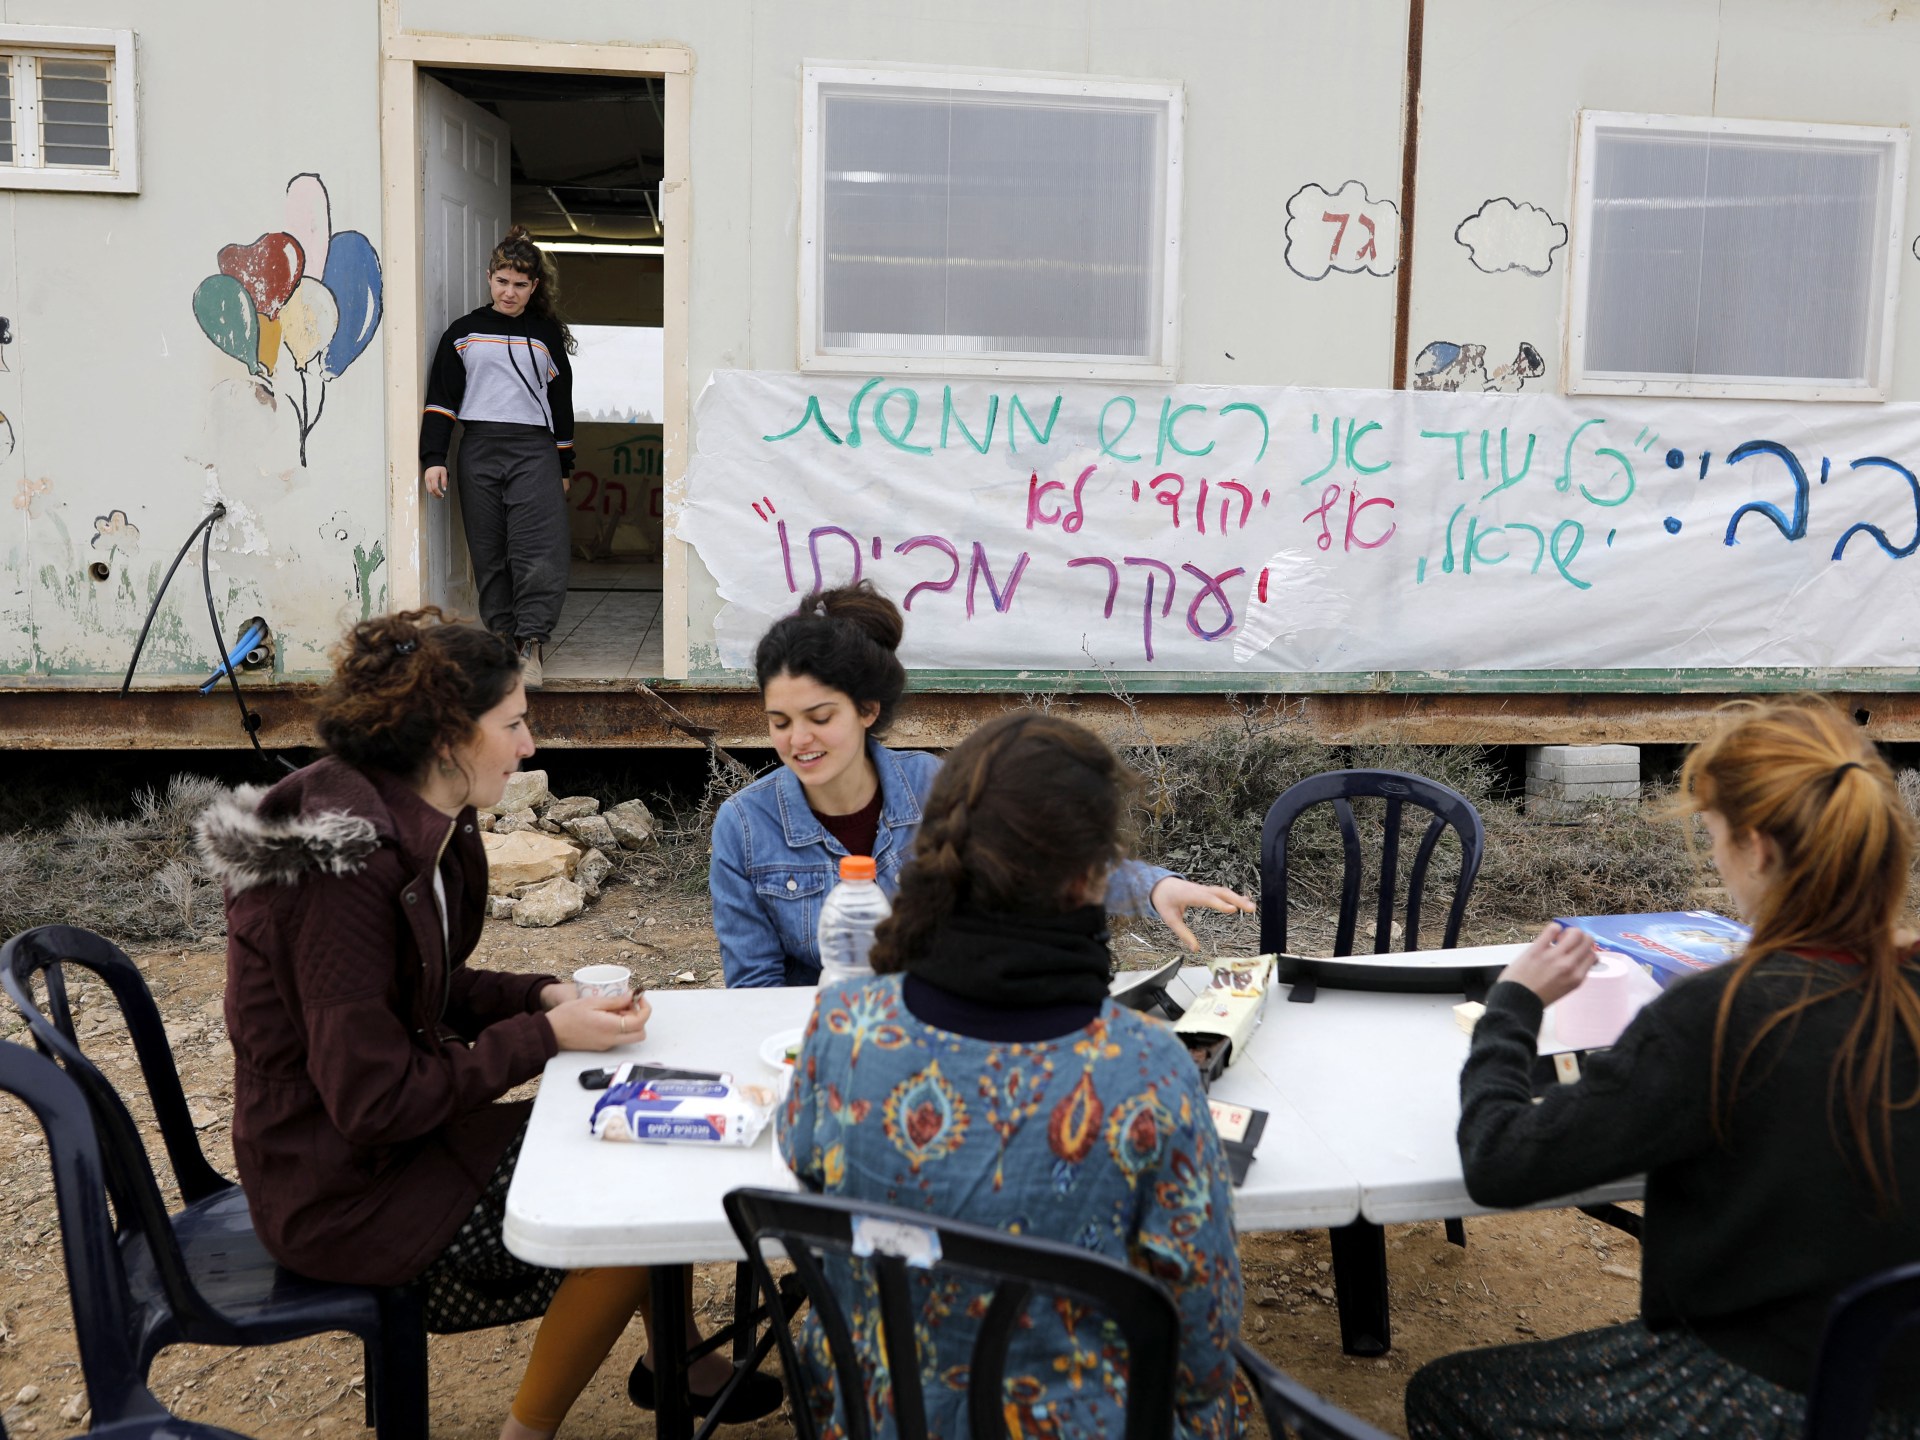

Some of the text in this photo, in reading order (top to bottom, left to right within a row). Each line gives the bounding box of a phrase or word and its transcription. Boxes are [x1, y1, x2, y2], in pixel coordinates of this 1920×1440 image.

[762, 376, 1063, 455] ממשלת
[1097, 396, 1269, 465] ראש
[1301, 414, 1392, 485] אני
[1026, 464, 1098, 534] לא
[1420, 426, 1536, 502] עוד
[1131, 472, 1271, 536] יהודי
[1302, 483, 1396, 552] אף
